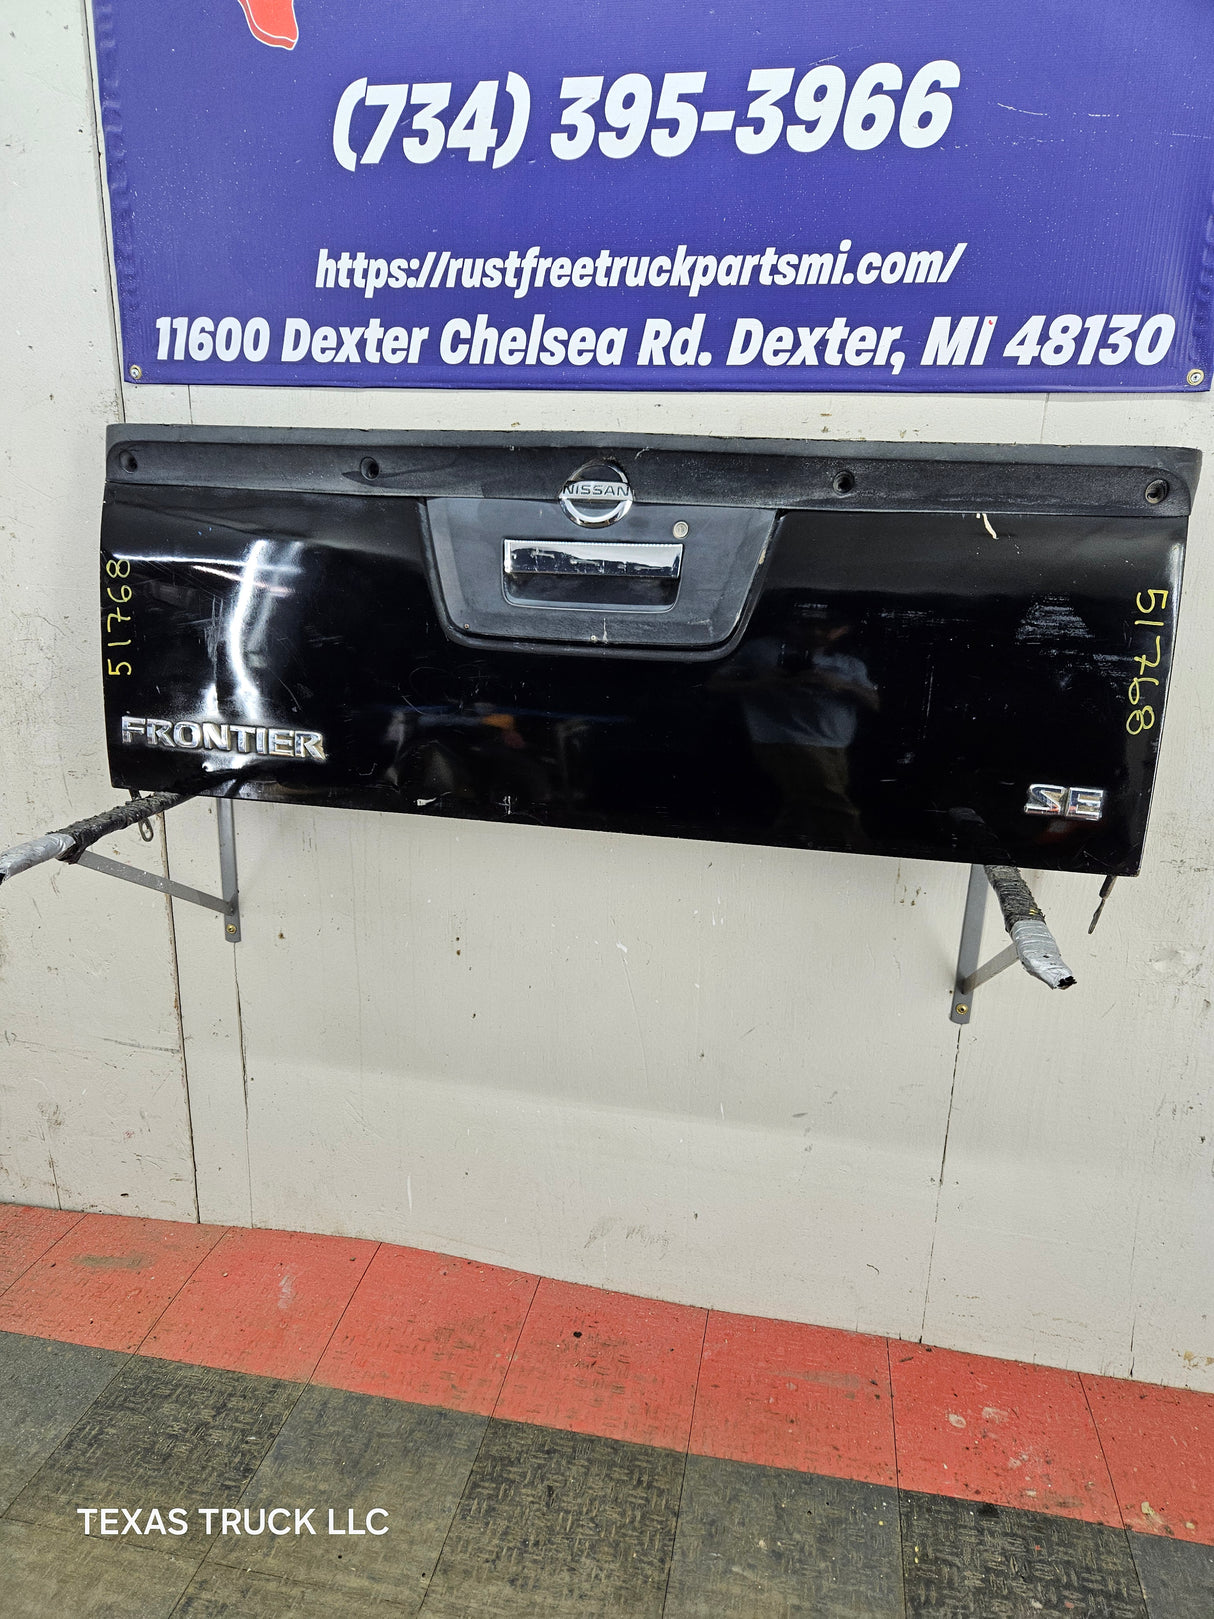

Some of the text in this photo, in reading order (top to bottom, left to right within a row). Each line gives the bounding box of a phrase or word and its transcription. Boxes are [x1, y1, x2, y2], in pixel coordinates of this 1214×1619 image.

[333, 60, 960, 172] (734) 395-3966
[315, 240, 967, 298] https://rustfreetruckpartsmi.com/
[155, 313, 1175, 375] 11600 Dexter Chelsea Rd. Dexter, MI 48130
[563, 484, 630, 497] NISSAN
[107, 558, 131, 676] 51768
[1126, 588, 1168, 734] 51768
[121, 716, 327, 760] FRONTIER
[1023, 783, 1105, 821] SE
